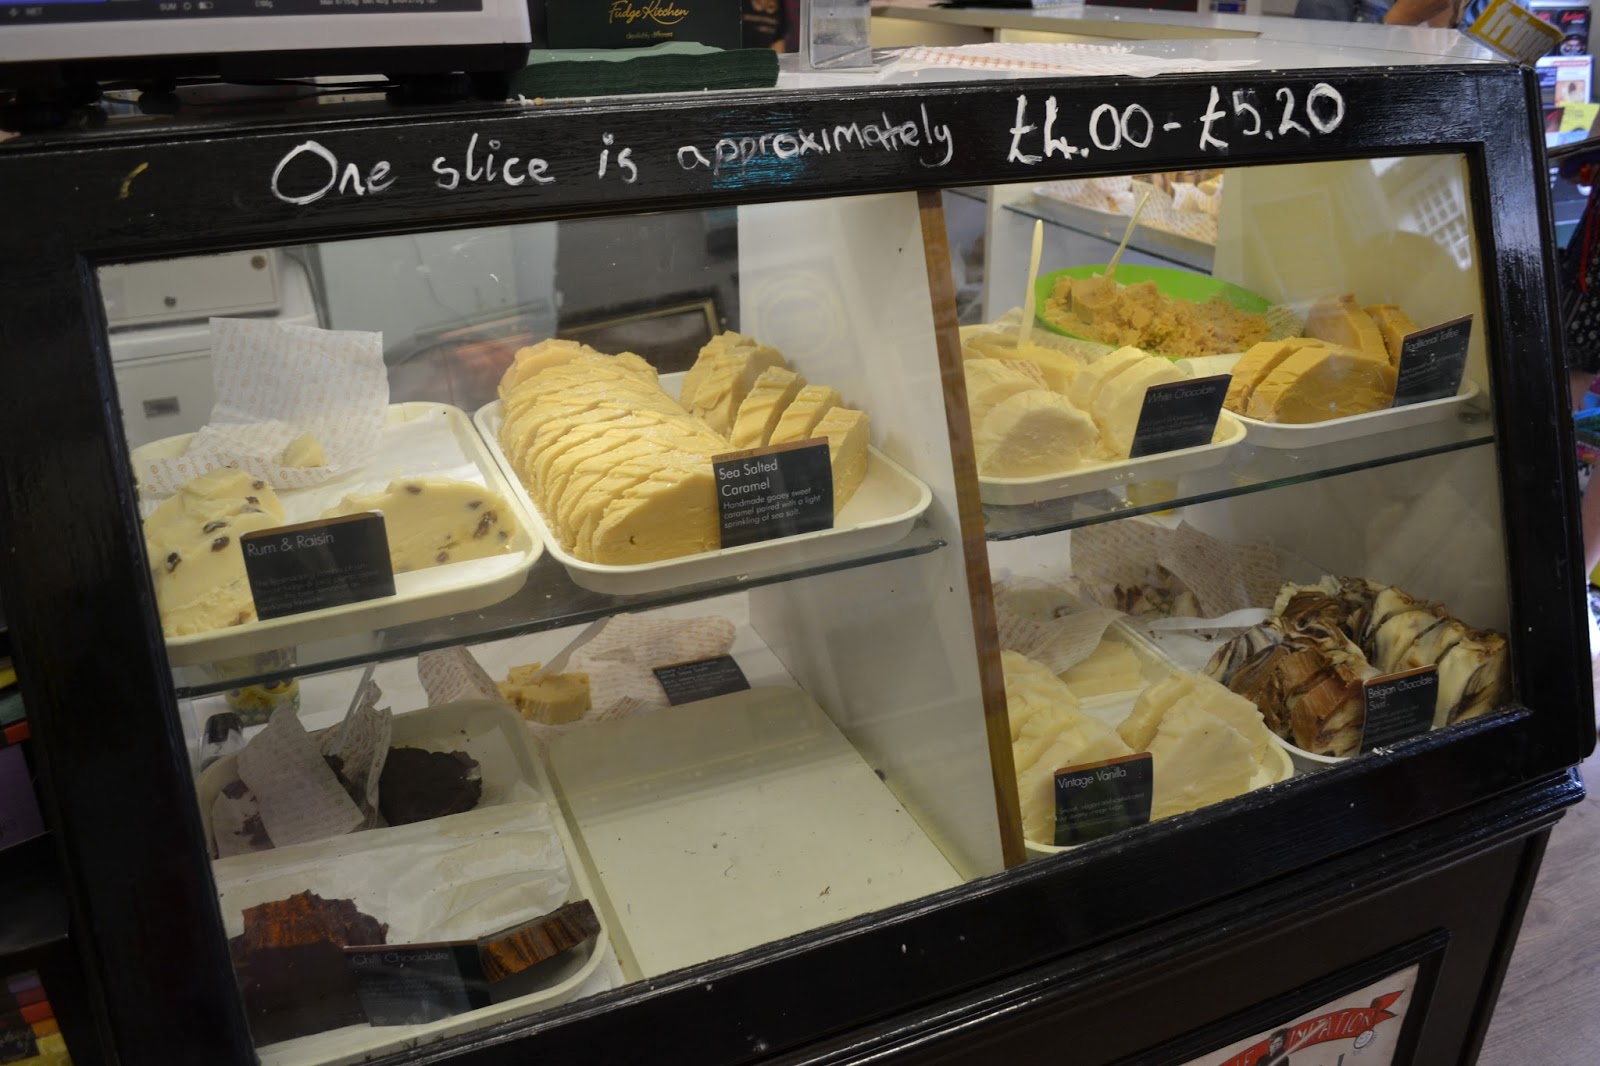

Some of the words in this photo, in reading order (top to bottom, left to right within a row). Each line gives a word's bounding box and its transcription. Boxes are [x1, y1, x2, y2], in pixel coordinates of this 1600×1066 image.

[608, 1, 642, 24] Fudge
[642, 0, 689, 25] Kitchen
[270, 140, 397, 205] One
[433, 133, 555, 192] slice
[598, 133, 638, 184] is
[677, 104, 953, 175] approximately
[1008, 94, 1153, 166] £4.00
[1199, 82, 1346, 152] £5.20
[1148, 390, 1172, 403] White
[1174, 385, 1216, 399] Chocolate
[718, 468, 740, 480] Sea
[743, 458, 778, 476] Salted
[721, 477, 770, 497] Caramel
[723, 497, 765, 510] Handmade
[766, 491, 790, 504] gooey
[791, 487, 812, 497] sweet
[723, 507, 754, 519] caramel
[756, 502, 780, 515] paired
[805, 495, 821, 505] light
[724, 514, 760, 529] sprinkling
[771, 512, 784, 520] sea
[246, 542, 277, 557] Rum
[280, 537, 293, 551] &
[296, 532, 335, 548] Raisin
[1367, 686, 1397, 700] Belgian
[1398, 676, 1433, 692] Chocolate
[1058, 775, 1094, 789] Vintage
[1096, 766, 1127, 781] Vanilla
[384, 951, 450, 963] Chocolate
